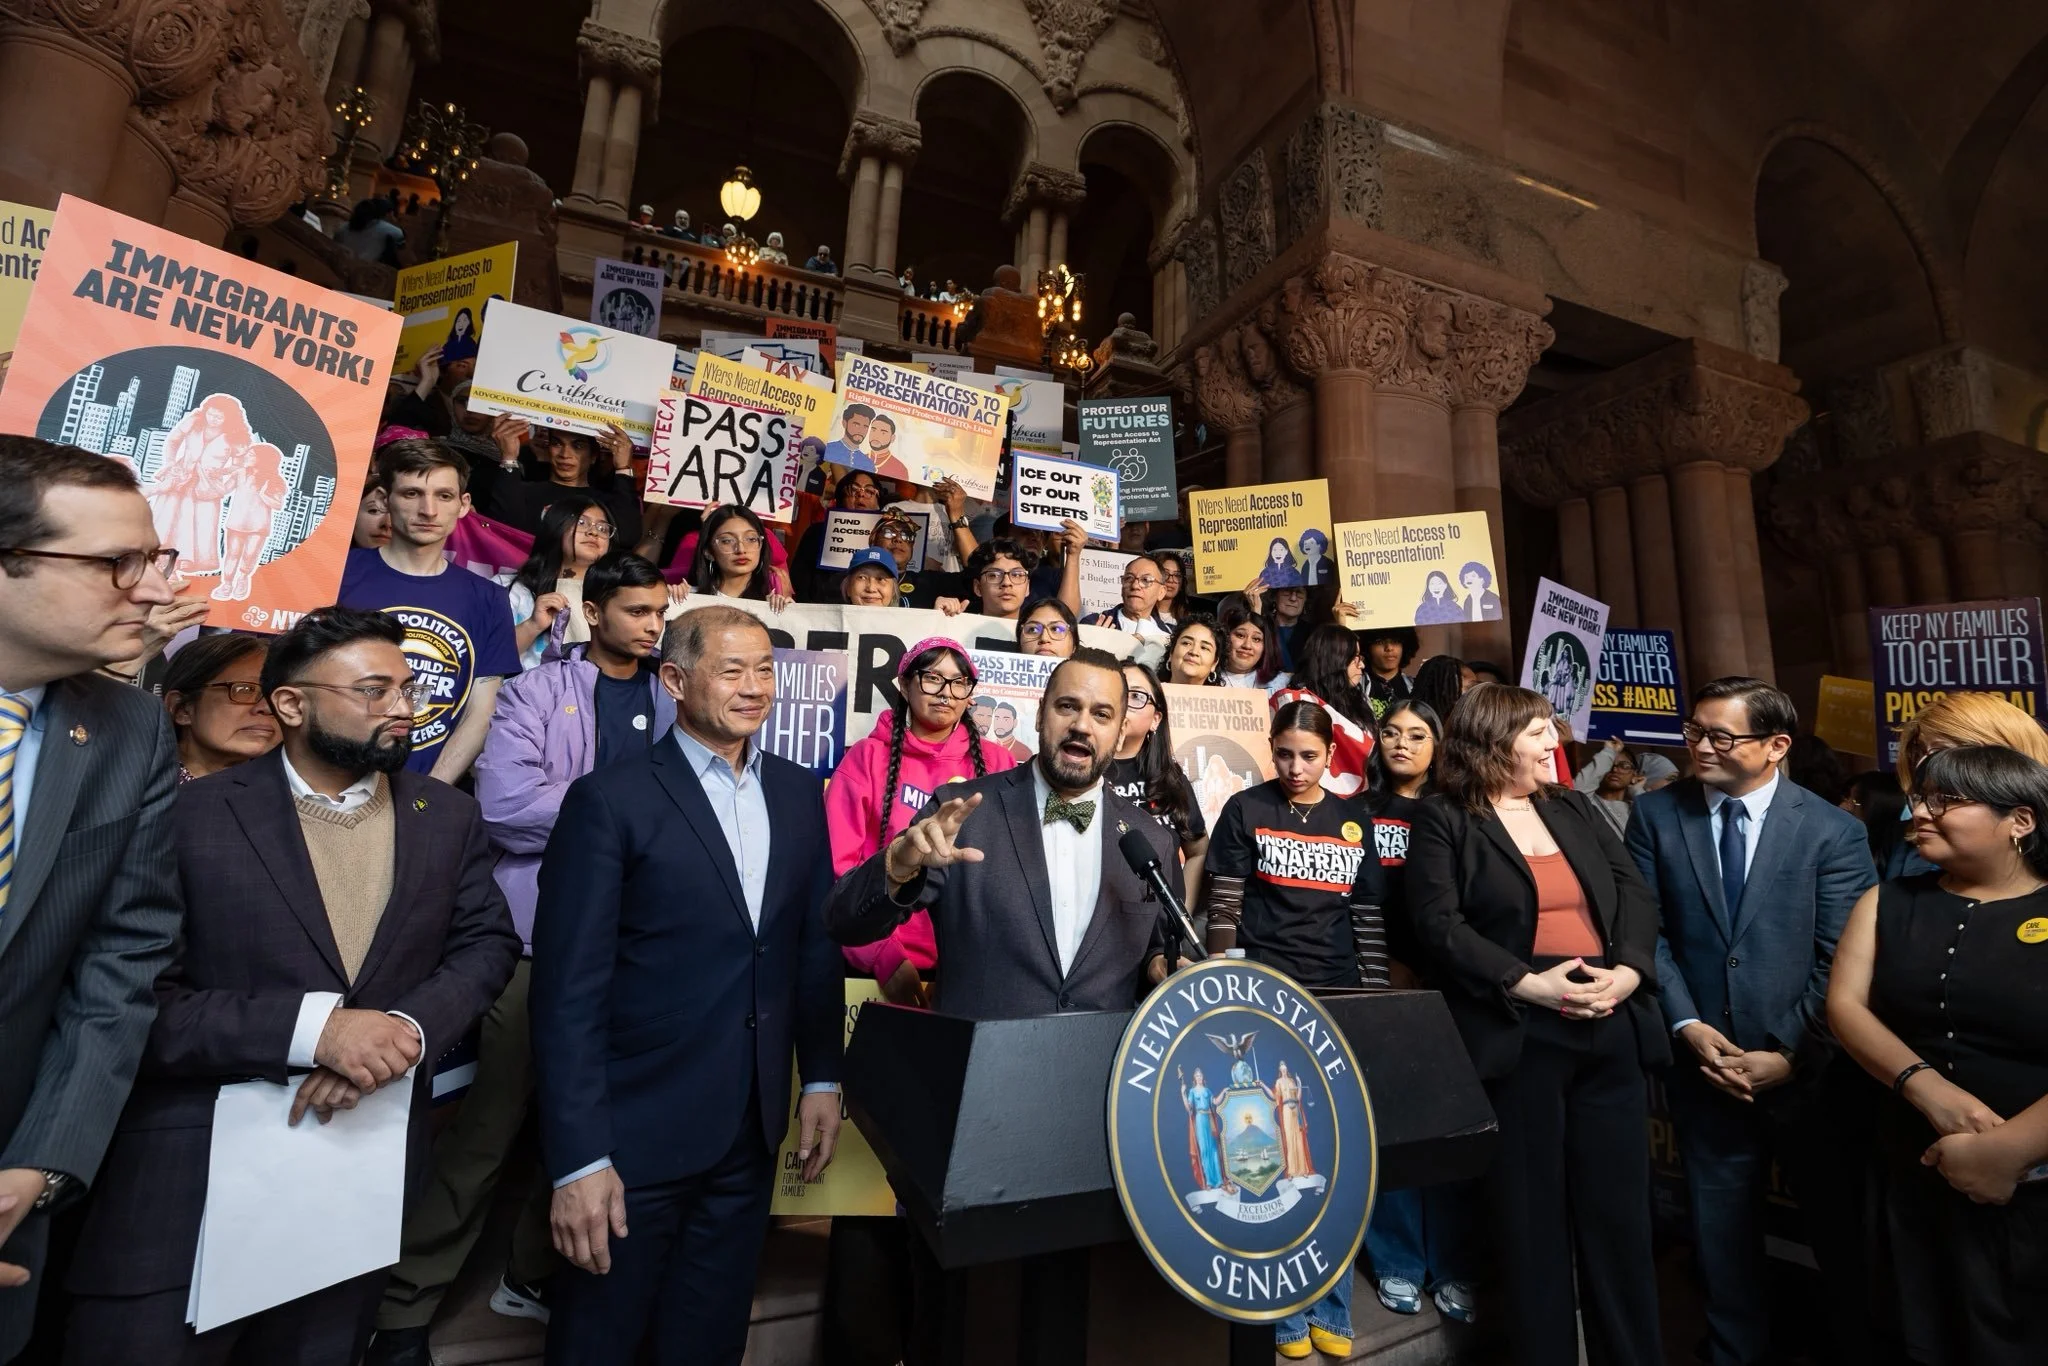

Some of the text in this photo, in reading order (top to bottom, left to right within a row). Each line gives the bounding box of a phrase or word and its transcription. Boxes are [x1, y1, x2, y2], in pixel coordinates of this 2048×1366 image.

[446, 263, 481, 282] Access
[482, 258, 492, 274] to
[600, 272, 659, 289] ARE NEW YORK!
[606, 264, 656, 281] IMMIGRANTS
[105, 239, 359, 349] IMMIGRANTS
[399, 278, 477, 313] Representation!
[72, 268, 375, 386] ARE NEW YORK!
[517, 370, 628, 408] Caribbean
[702, 362, 817, 412] NYers Need Access to
[852, 359, 1000, 411] PASS THE ACCESS TO
[473, 390, 524, 405] ADVOCATING
[526, 401, 541, 410] FOR
[542, 404, 580, 418] CARIBBEAN
[561, 396, 624, 414] EQUALITY PROJECT
[846, 373, 1001, 427] REPRESENTATION ACT
[848, 391, 870, 404] Right
[881, 401, 911, 415] Counsel
[911, 409, 943, 422] Protects
[1082, 403, 1167, 416] PROTECT OUR
[682, 398, 787, 459] PASS
[1082, 414, 1170, 430] FUTURES
[646, 399, 677, 493] MIXTECA
[1093, 437, 1147, 446] Representation
[668, 444, 776, 513] ARA
[779, 424, 804, 510] MIXTECA
[1020, 467, 1082, 485] ICE OUT
[1020, 485, 1080, 502] OF OUR
[1197, 491, 1303, 516] NYers Need Access to
[834, 518, 861, 526] FUND
[1020, 502, 1088, 521] STREETS
[1199, 509, 1288, 536] Representation!
[832, 527, 870, 536] ACCESS
[1343, 523, 1460, 548] NYers Need Access to
[829, 546, 860, 554] REPR
[1202, 538, 1239, 553] ACT NOW!
[1345, 542, 1445, 570] Representation!
[1092, 559, 1120, 570] Million
[1087, 573, 1115, 585] Budget
[1351, 571, 1391, 587] ACT NOW!
[1547, 590, 1600, 622] IMMIGRANTS
[1540, 602, 1602, 637] ARE NEW YORK!
[1881, 607, 2030, 640] KEEP NY FAMILIES
[397, 613, 468, 658] POLITICAL
[1619, 633, 1669, 653] FAMILIES
[1009, 658, 1035, 672] THE
[1882, 638, 2036, 686] TOGETHER
[1622, 686, 1677, 710] #ARA!
[1188, 713, 1220, 730] NEW
[1222, 715, 1264, 732] YORK!
[1256, 834, 1366, 857] UNDOCUMENTED
[1258, 844, 1363, 873] UNAFRAID
[1127, 974, 1349, 1094] NEW YORK STATE
[1238, 1198, 1284, 1215] EXCELSIOR
[1206, 1239, 1330, 1301] SENATE
